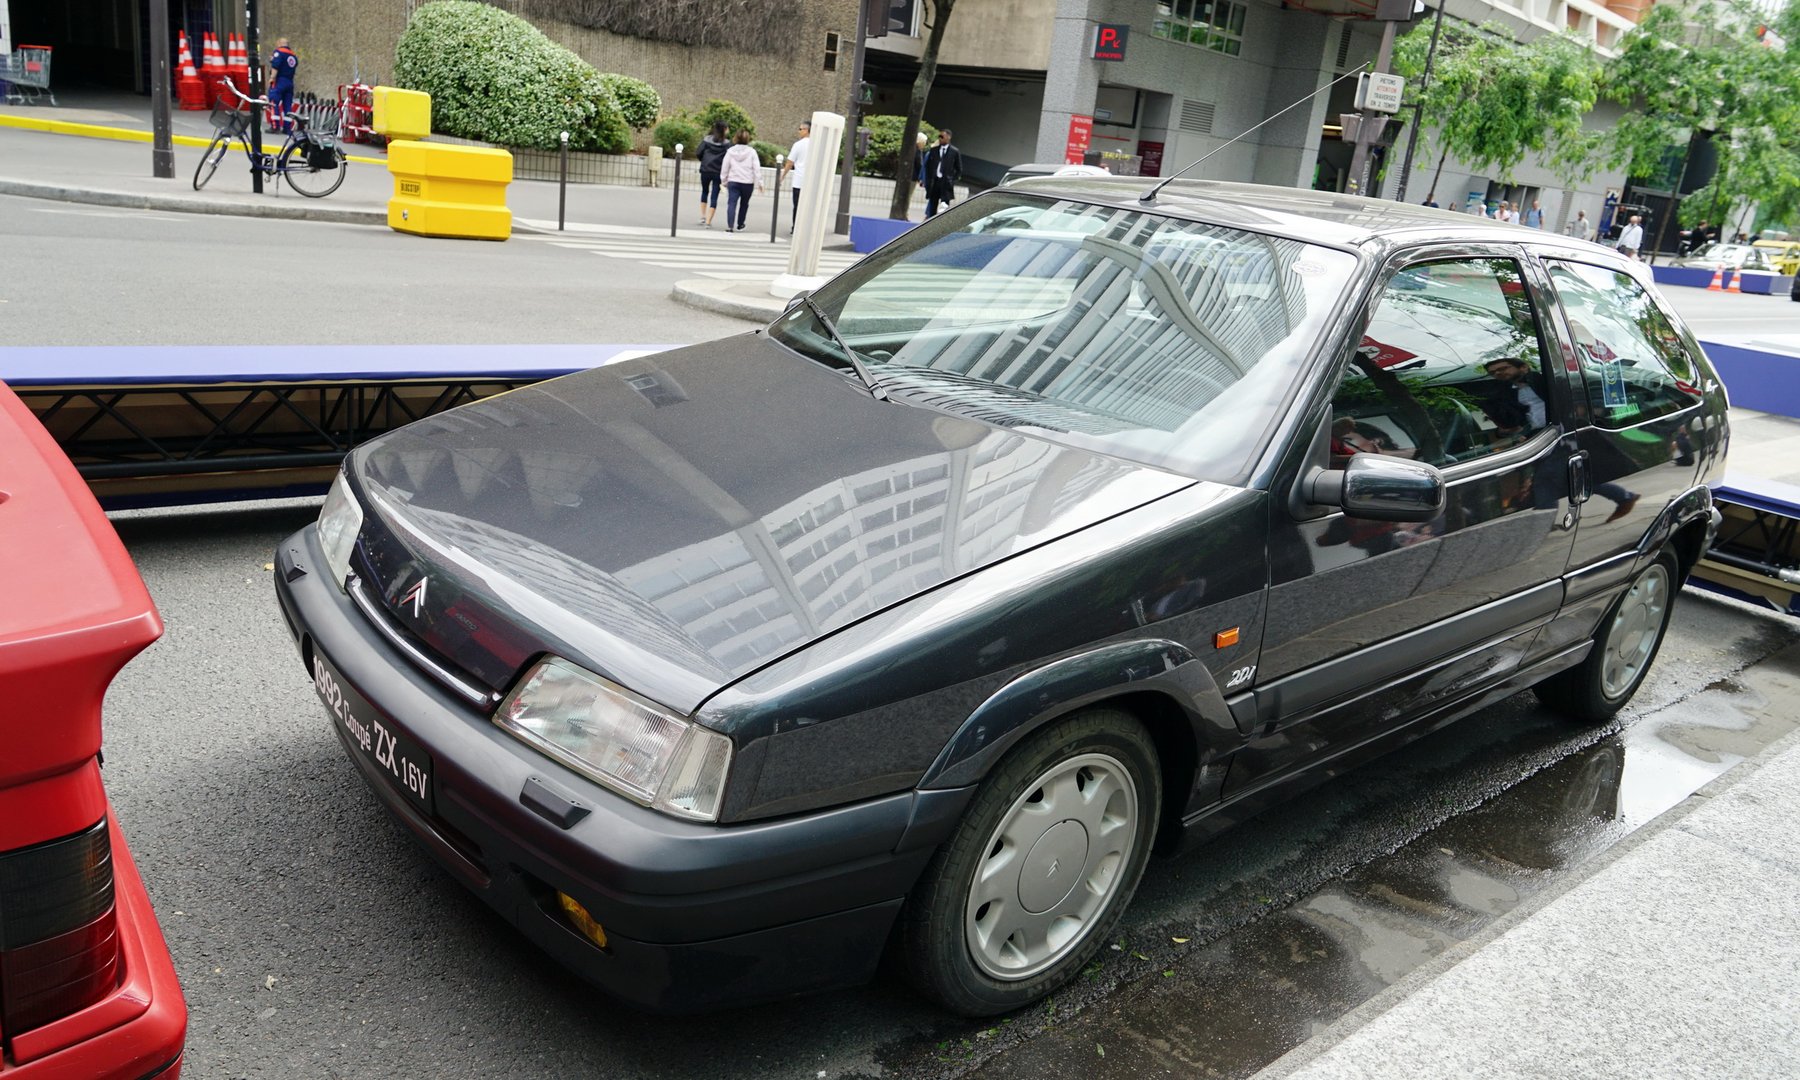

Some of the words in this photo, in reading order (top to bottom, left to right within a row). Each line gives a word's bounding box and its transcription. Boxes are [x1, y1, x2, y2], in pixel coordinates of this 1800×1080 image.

[1100, 28, 1117, 47] P
[1376, 85, 1398, 94] ATTENTION
[313, 655, 343, 720] 1992
[343, 700, 371, 751] Coupé
[374, 720, 399, 777] ZX
[401, 757, 427, 800] 16V
